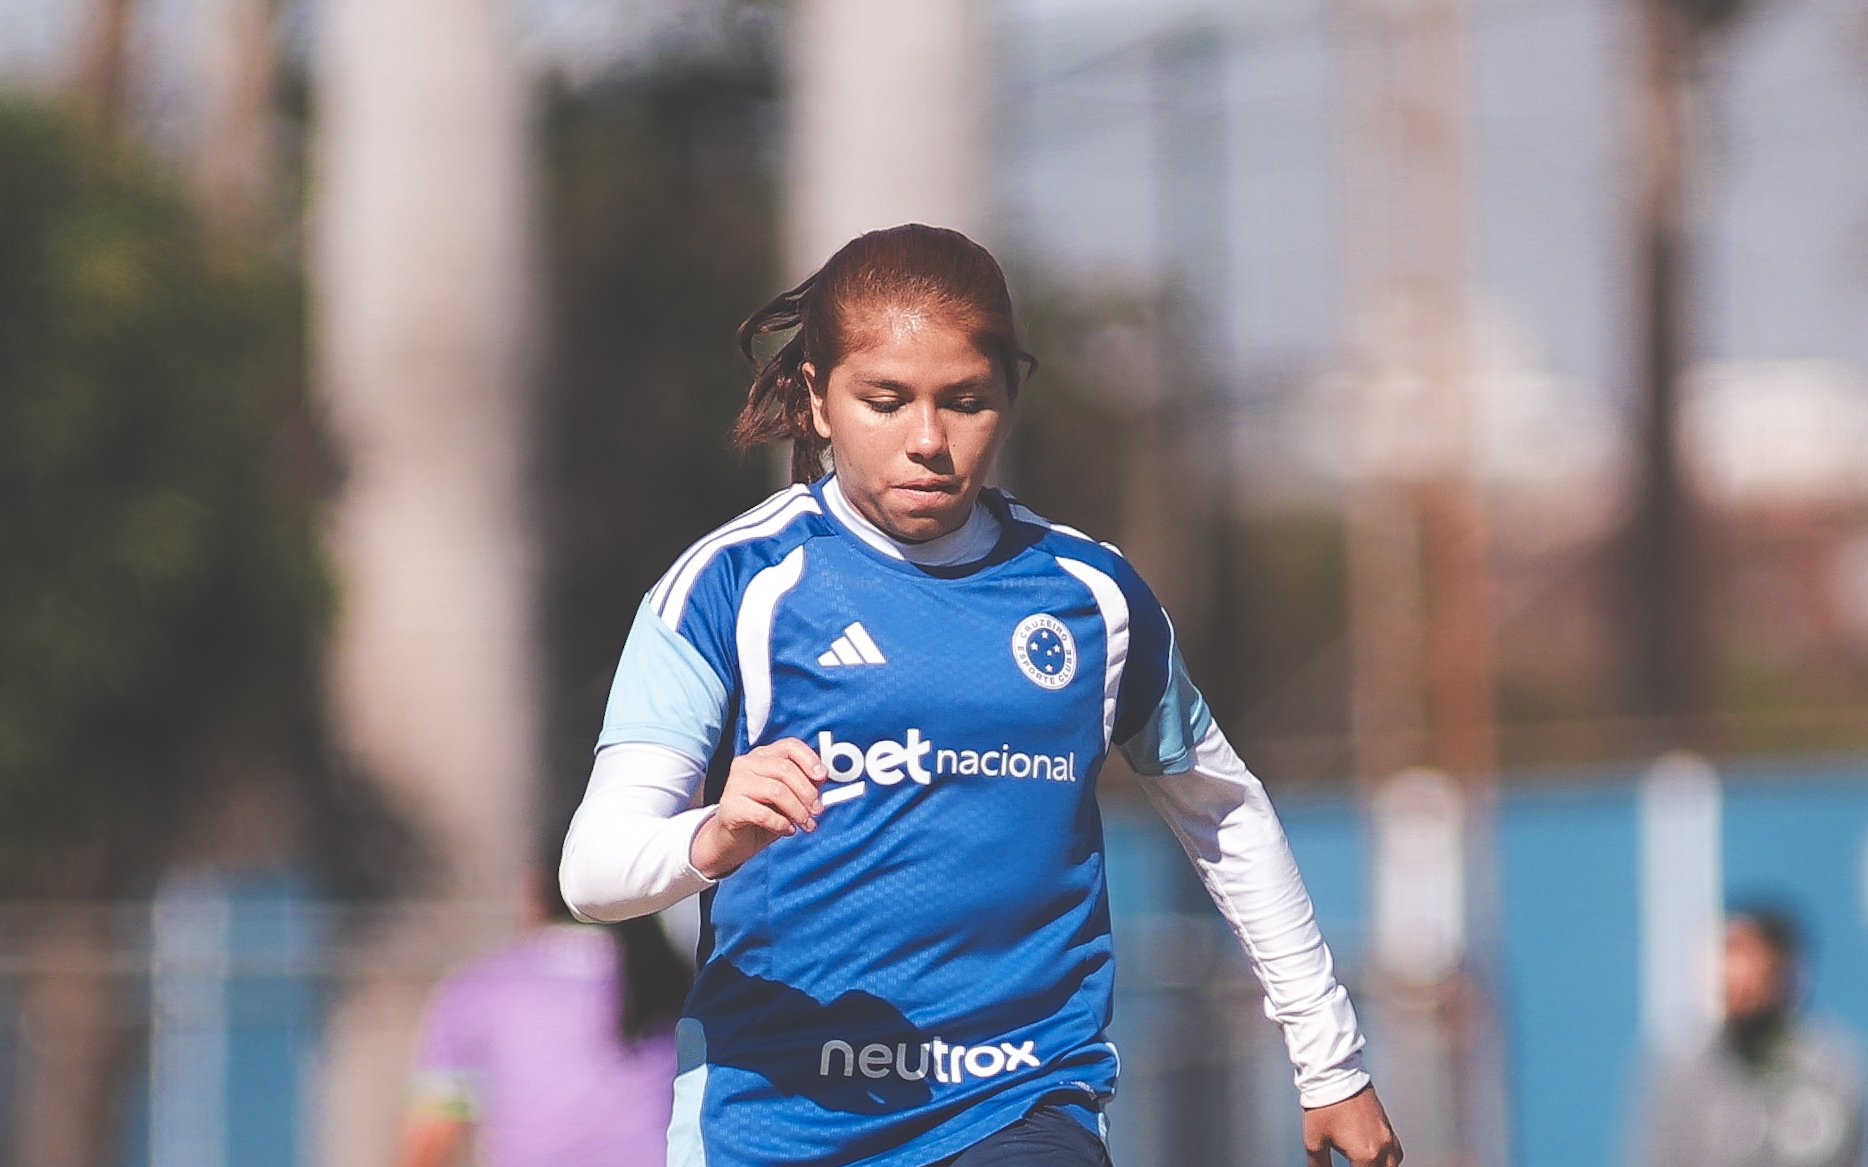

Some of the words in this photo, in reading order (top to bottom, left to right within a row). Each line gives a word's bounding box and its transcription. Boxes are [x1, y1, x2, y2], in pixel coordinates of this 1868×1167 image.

[1020, 619, 1068, 641] CRUZEIRO
[1017, 645, 1056, 685] ESPORTE
[1058, 649, 1072, 683] CLUBE
[819, 1036, 1041, 1084] neutrox
